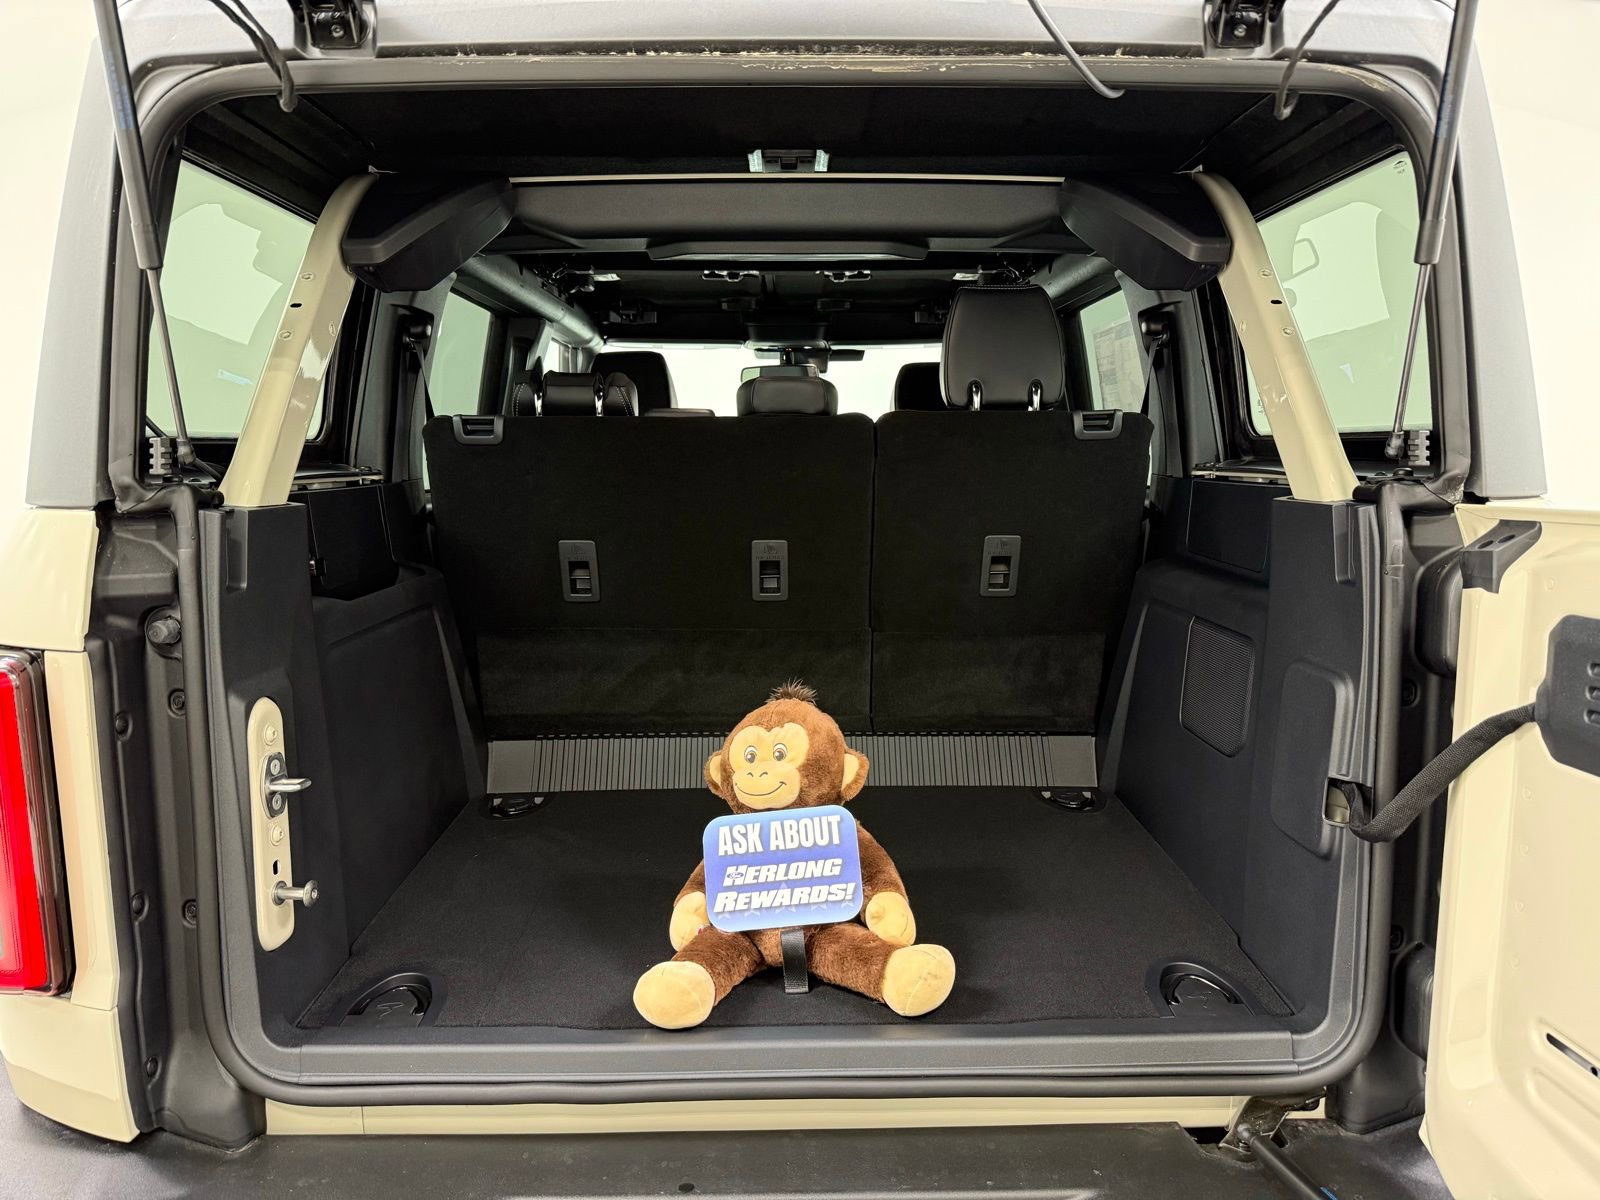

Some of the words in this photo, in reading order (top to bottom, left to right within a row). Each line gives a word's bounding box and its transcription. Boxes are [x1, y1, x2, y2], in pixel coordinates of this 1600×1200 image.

[719, 823, 763, 856] ASK
[770, 816, 841, 851] ABOUT
[724, 858, 842, 886] HERLONG
[714, 884, 856, 912] REWARDS!
